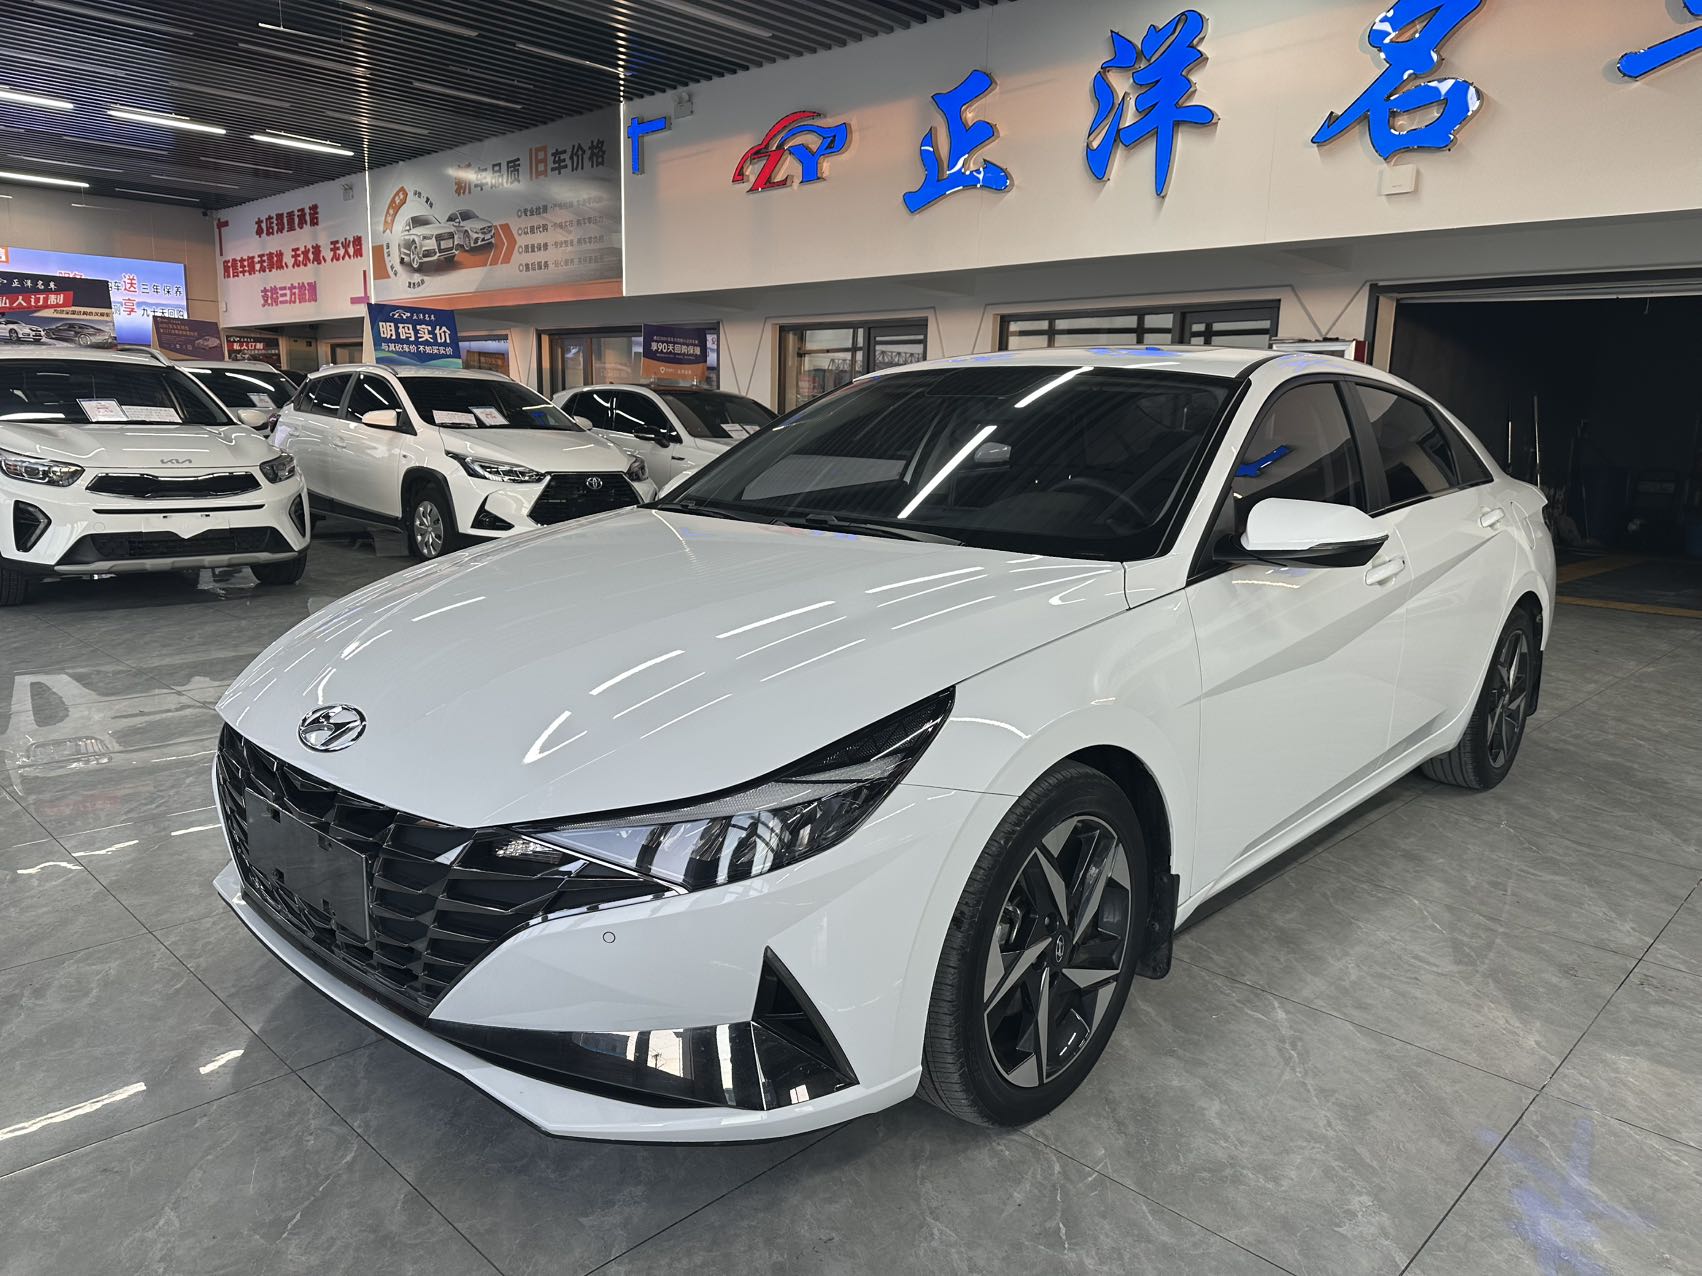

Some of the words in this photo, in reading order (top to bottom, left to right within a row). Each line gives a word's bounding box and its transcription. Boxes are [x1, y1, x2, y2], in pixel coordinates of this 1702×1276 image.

[454, 158, 521, 197] 新车品质
[528, 138, 606, 181] 旧车价格
[255, 204, 319, 238] 本店郑重承诺
[11, 279, 58, 291] 正洋名车
[261, 281, 318, 308] 支持三方检测
[379, 321, 450, 343] 明码实价
[382, 342, 417, 353] 与其砍车价
[418, 345, 453, 355] 不如买实价
[650, 342, 701, 356] 享90天回购保障
